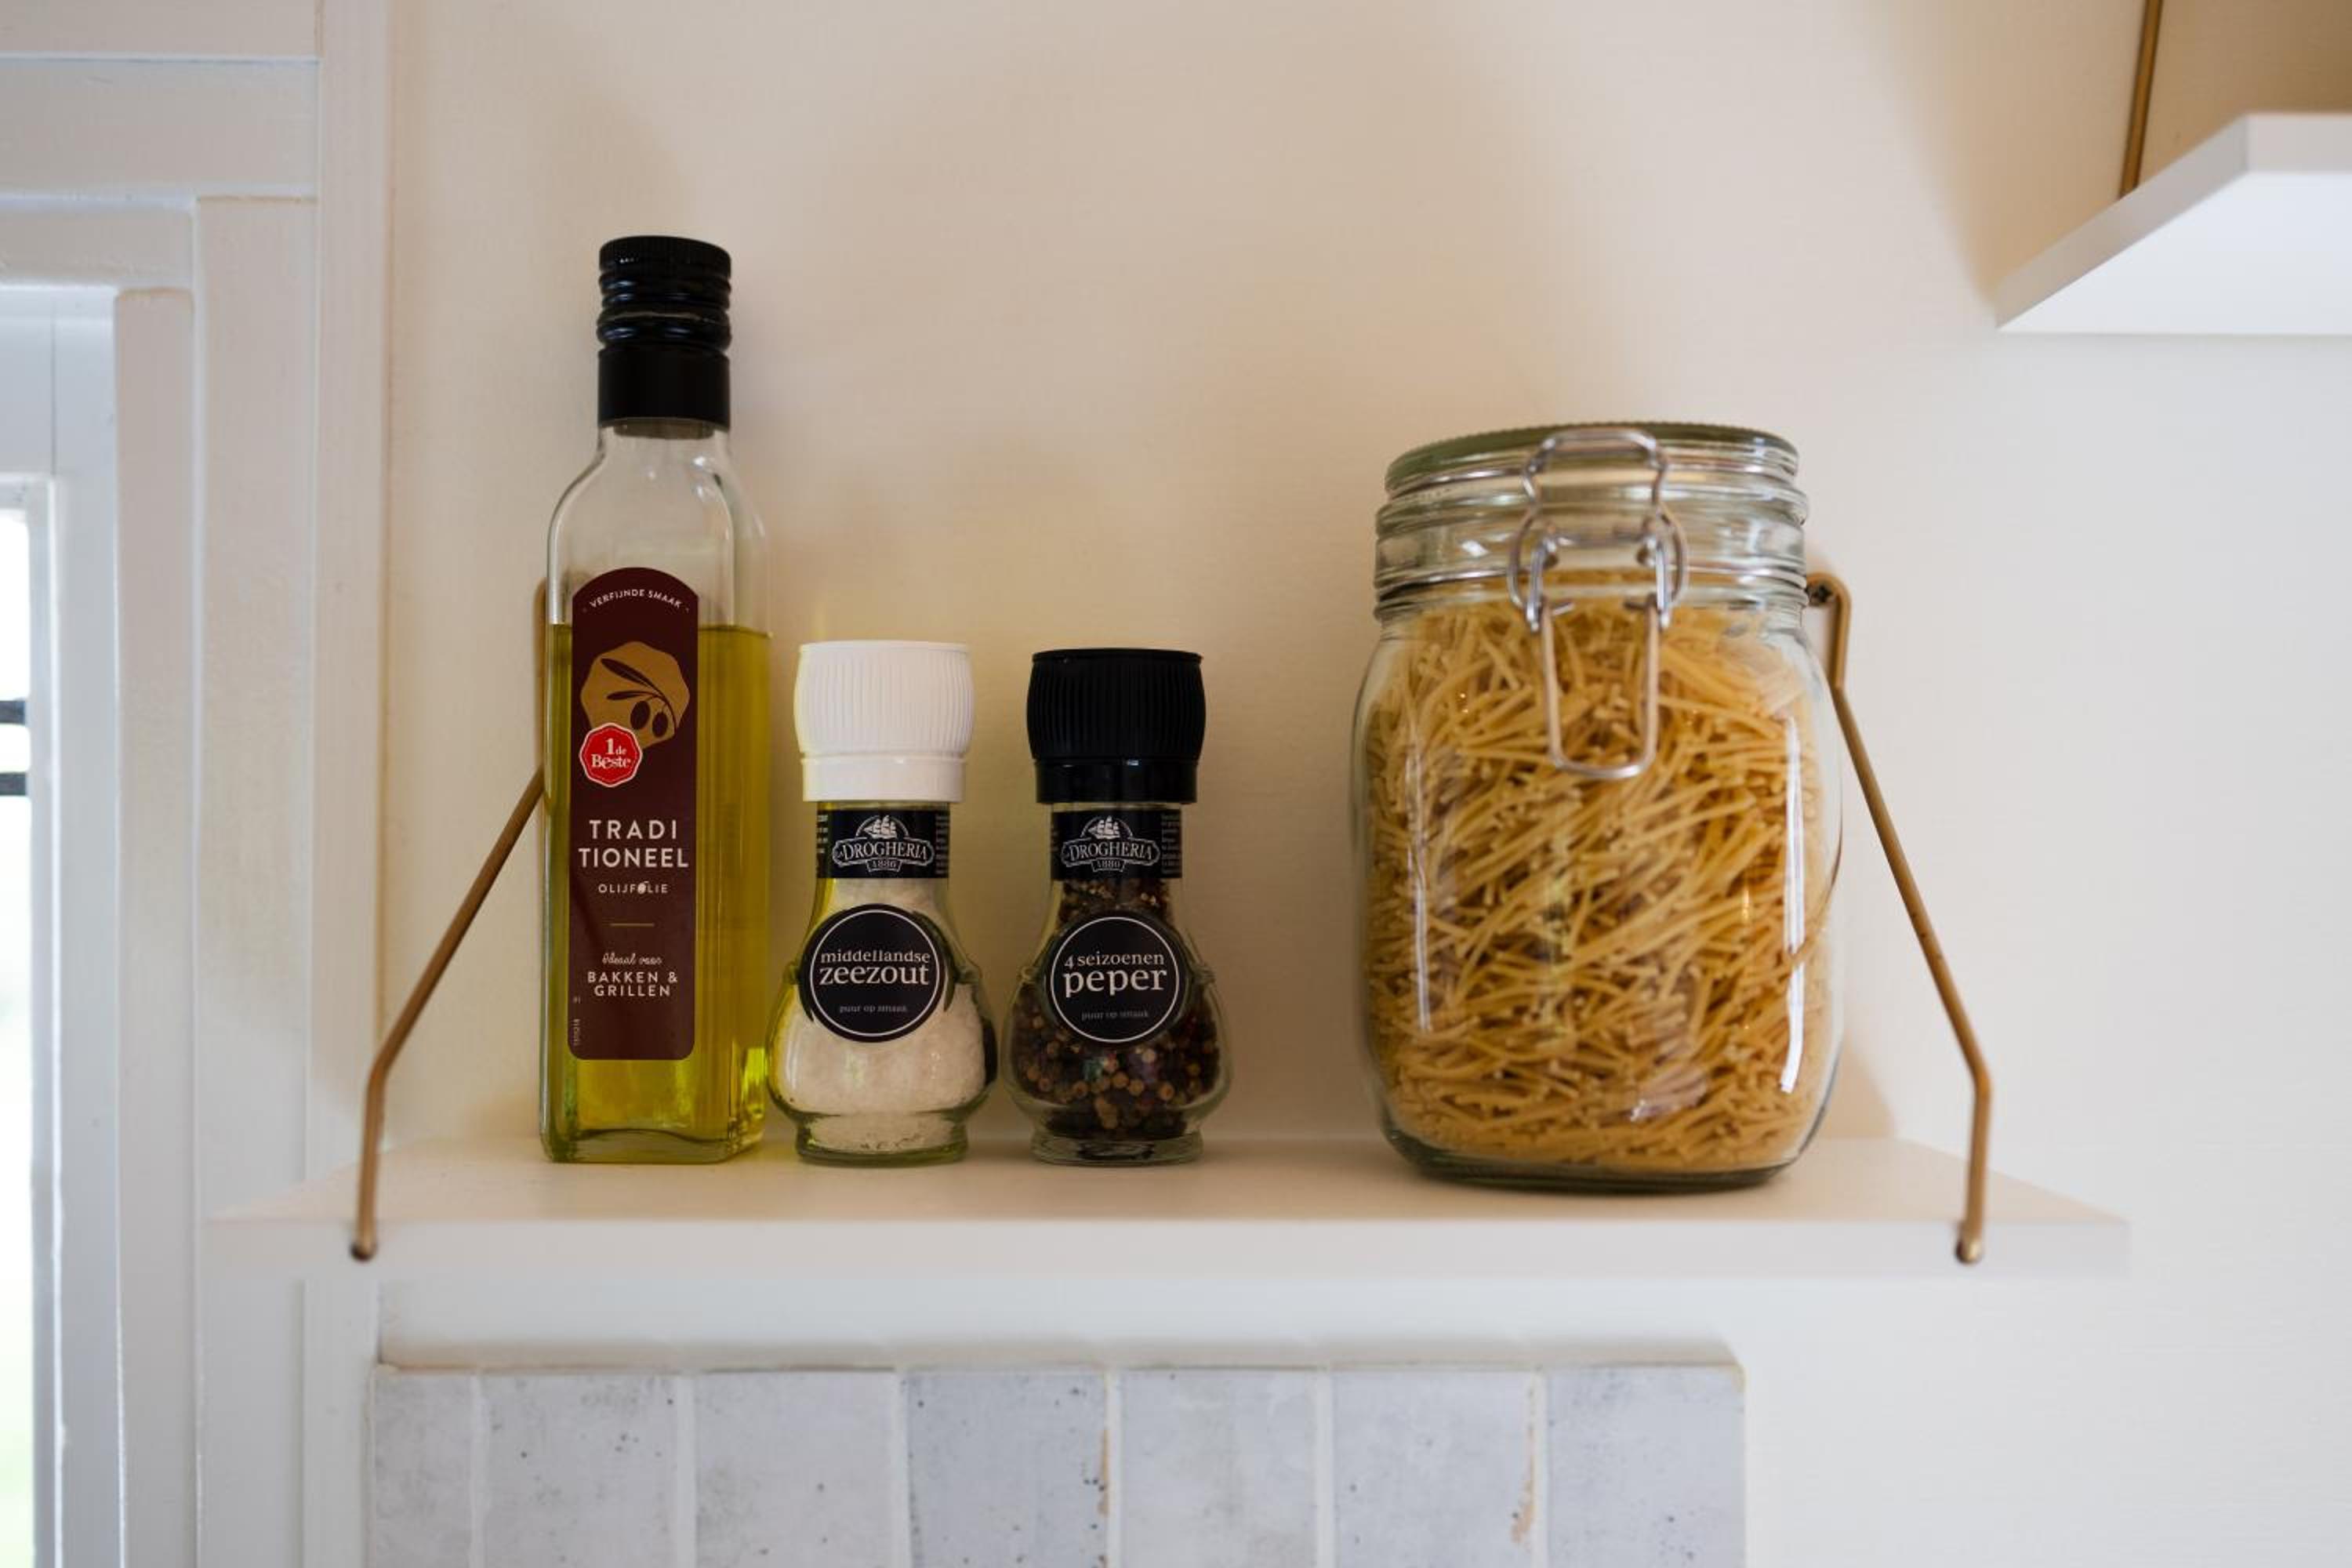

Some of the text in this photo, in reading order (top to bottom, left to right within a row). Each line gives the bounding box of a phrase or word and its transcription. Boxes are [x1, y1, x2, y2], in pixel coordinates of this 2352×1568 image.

[590, 589, 682, 608] VERFIJNDE SMAAK
[591, 753, 631, 769] Beste
[590, 819, 677, 840] TRADI
[579, 848, 689, 868] TIONEEL
[843, 841, 927, 860] DROGHERIA
[1069, 841, 1152, 861] DROGHERIA
[821, 949, 931, 964] middellandse
[1064, 950, 1164, 970] 4 seizoenen
[588, 971, 678, 984] BAKKEN &
[819, 965, 929, 985] zeezout
[1063, 968, 1167, 998] peper
[594, 984, 670, 996] GRILLEN
